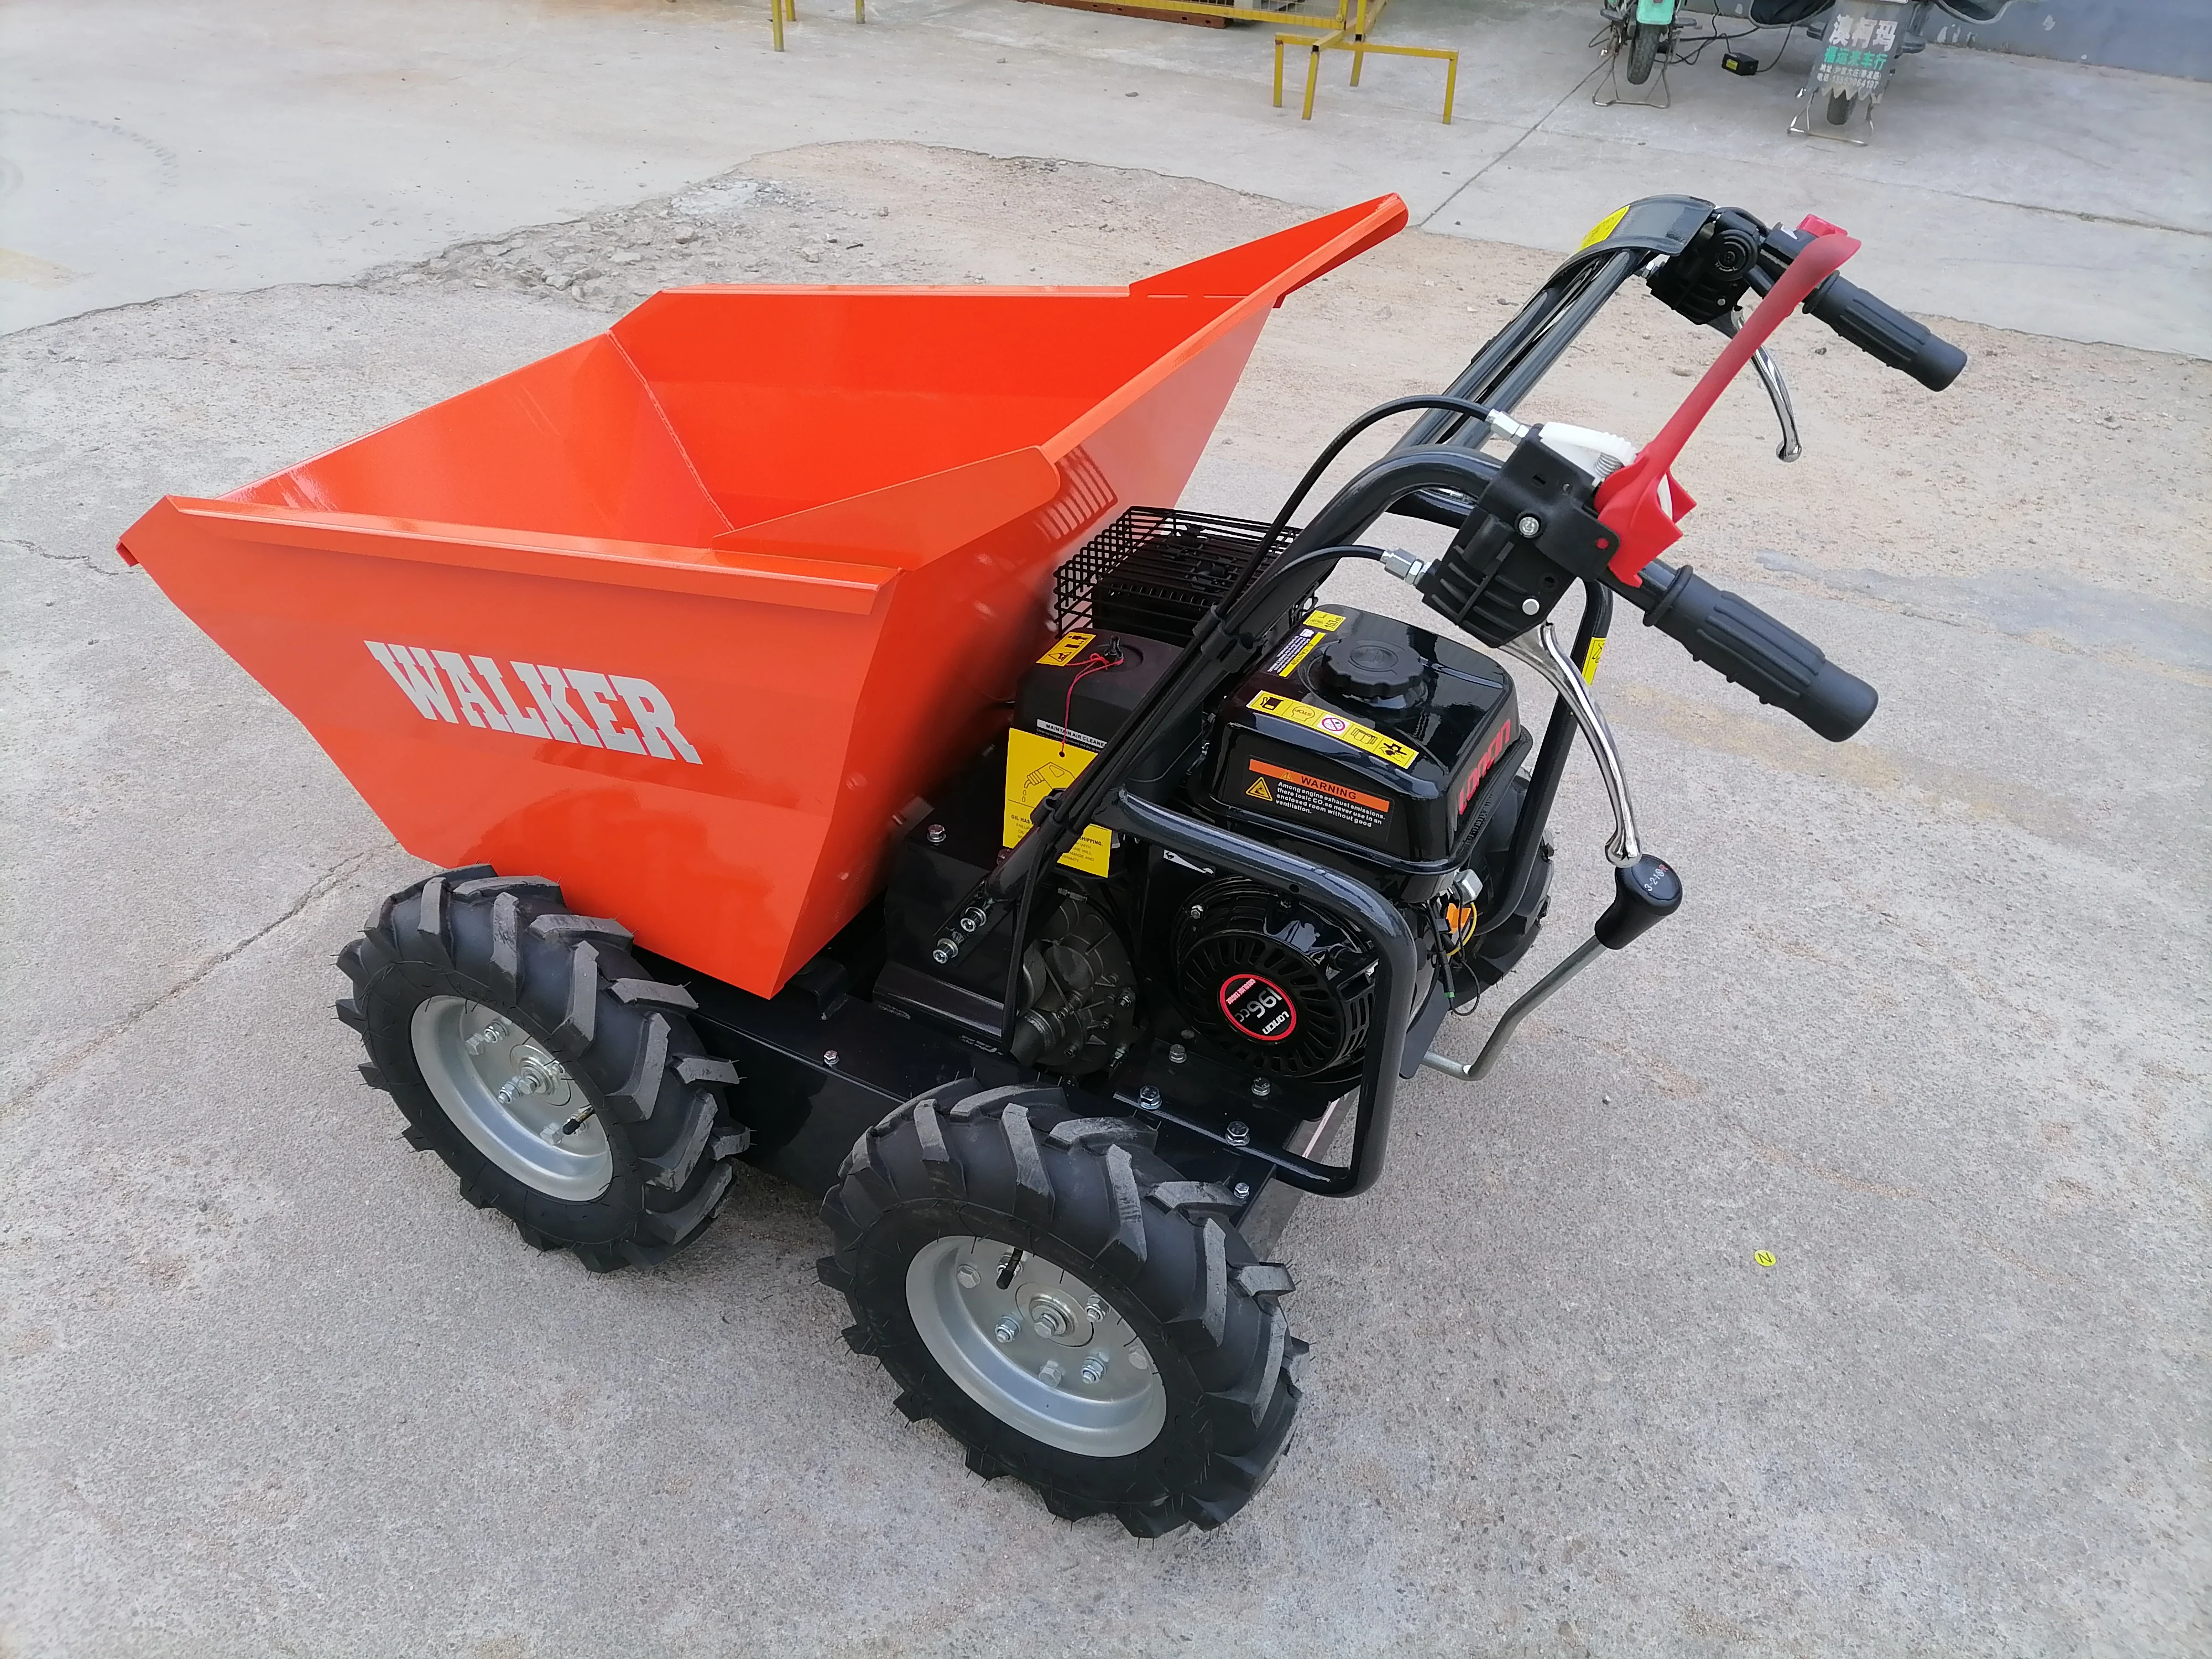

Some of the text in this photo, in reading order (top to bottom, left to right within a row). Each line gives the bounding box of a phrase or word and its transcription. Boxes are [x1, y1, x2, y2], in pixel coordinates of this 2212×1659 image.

[1291, 649, 1308, 666] CAUTION
[363, 640, 703, 764] WALKER
[1082, 737, 1106, 748] CLEANE
[1277, 781, 1301, 793] Among
[1301, 788, 1323, 800] engine
[1324, 796, 1350, 808] exhaust
[1277, 787, 1294, 796] there
[1295, 792, 1312, 801] toxic
[1333, 805, 1353, 815] never
[1301, 776, 1357, 800] WARNING
[1276, 794, 1372, 827] enclosed room without good
